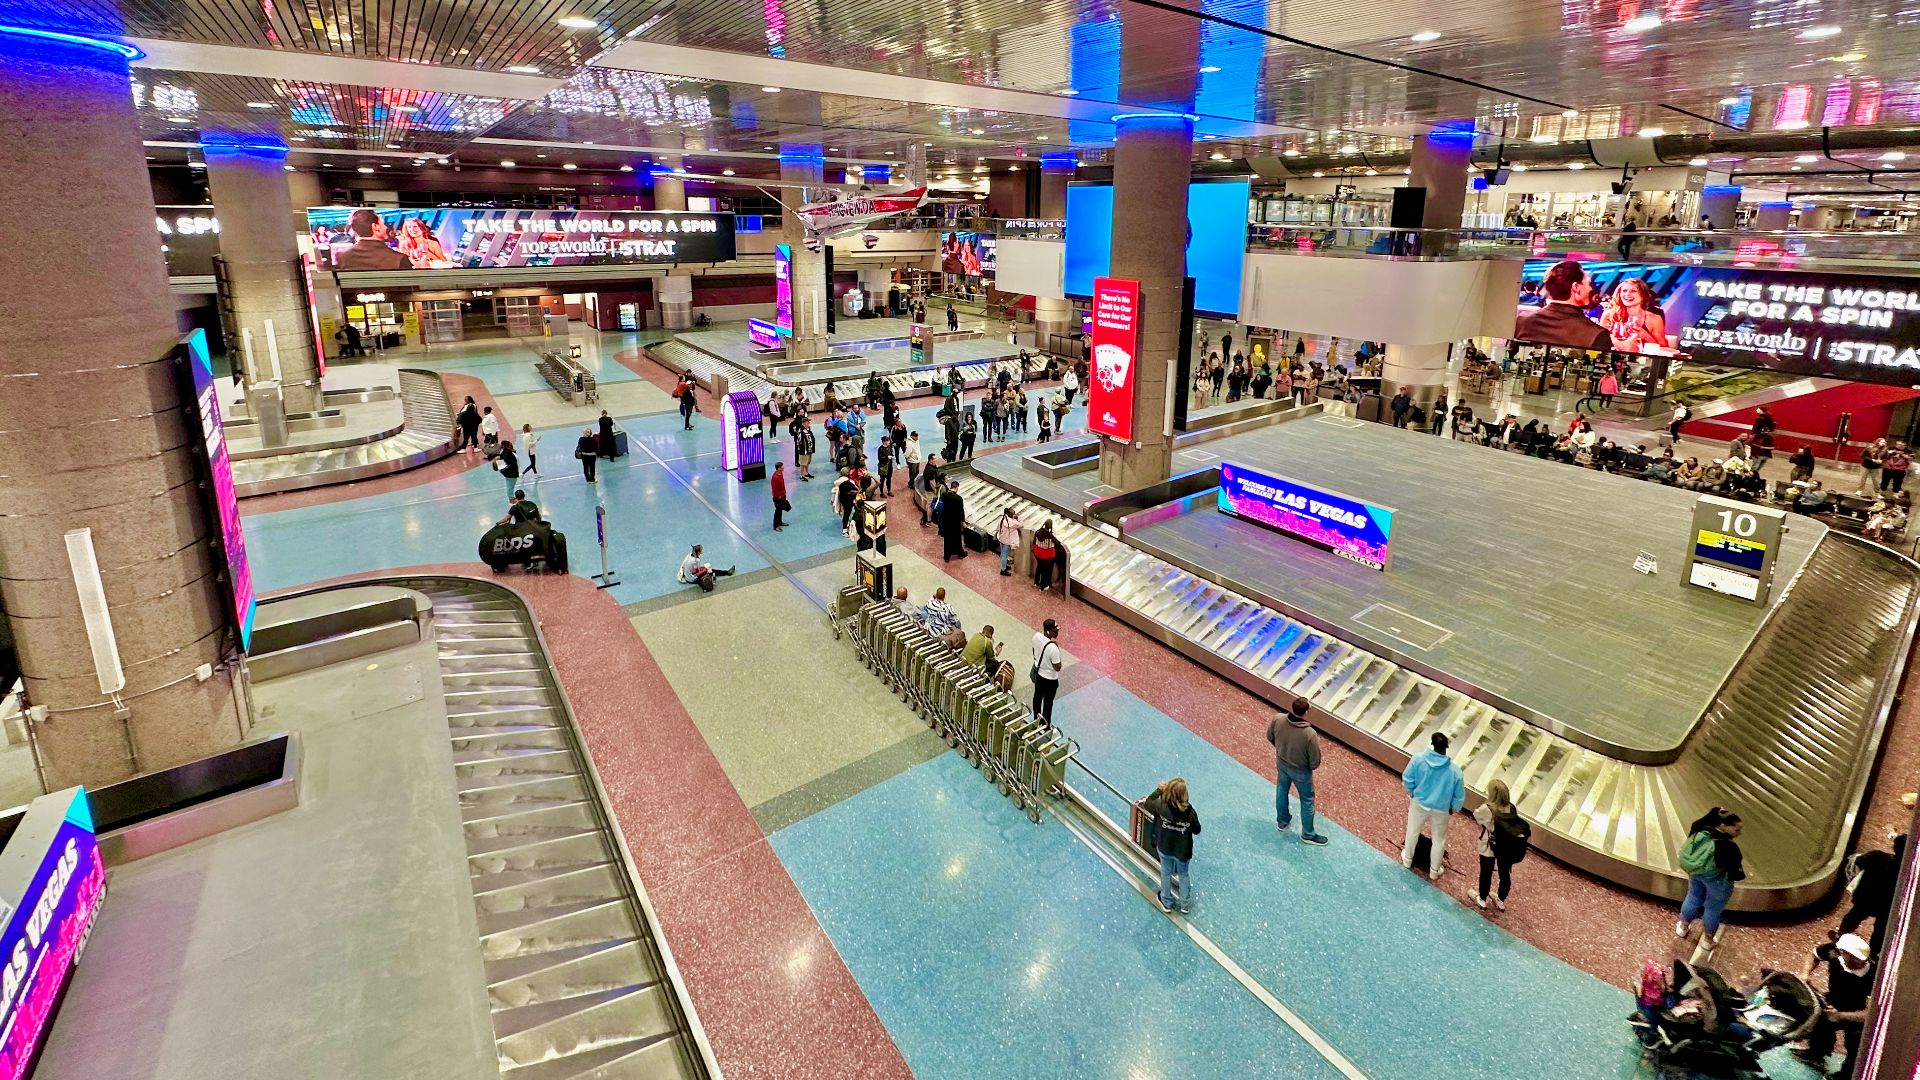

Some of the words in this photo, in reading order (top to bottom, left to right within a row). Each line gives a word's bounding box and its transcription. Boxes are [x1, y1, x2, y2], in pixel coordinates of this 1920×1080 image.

[462, 219, 515, 233] TAKE
[519, 219, 557, 233] THE
[560, 219, 625, 233] WORLD
[628, 219, 663, 233] FOR
[666, 219, 679, 233] A
[681, 220, 717, 233] SPIN
[519, 241, 549, 254] TOP
[559, 235, 606, 253] WORLD
[622, 240, 676, 256] STRAT
[1100, 293, 1121, 303] There's
[1121, 295, 1131, 304] No
[1695, 280, 1763, 300] TAKE
[1767, 284, 1825, 304] THE
[1097, 310, 1111, 319] Care
[1111, 312, 1120, 320] for
[1120, 313, 1132, 322] Our
[1098, 301, 1113, 310] Limit
[1113, 303, 1120, 311] to
[1120, 304, 1132, 313] Our
[1730, 300, 1787, 320] FOR
[1791, 304, 1814, 322] A
[1820, 306, 1894, 328] SPIN
[914, 326, 920, 337] 9
[1097, 319, 1131, 331] Customers!
[1682, 326, 1721, 342] TOP
[1735, 327, 1807, 350] WORLD
[1833, 341, 1920, 370] STRA
[1266, 486, 1276, 495] TO
[1273, 489, 1307, 510] LAS
[1309, 499, 1368, 529] VEGAS
[1717, 510, 1757, 537] 10
[1336, 550, 1376, 568] LAMAR
[25, 837, 78, 949] VEGAS
